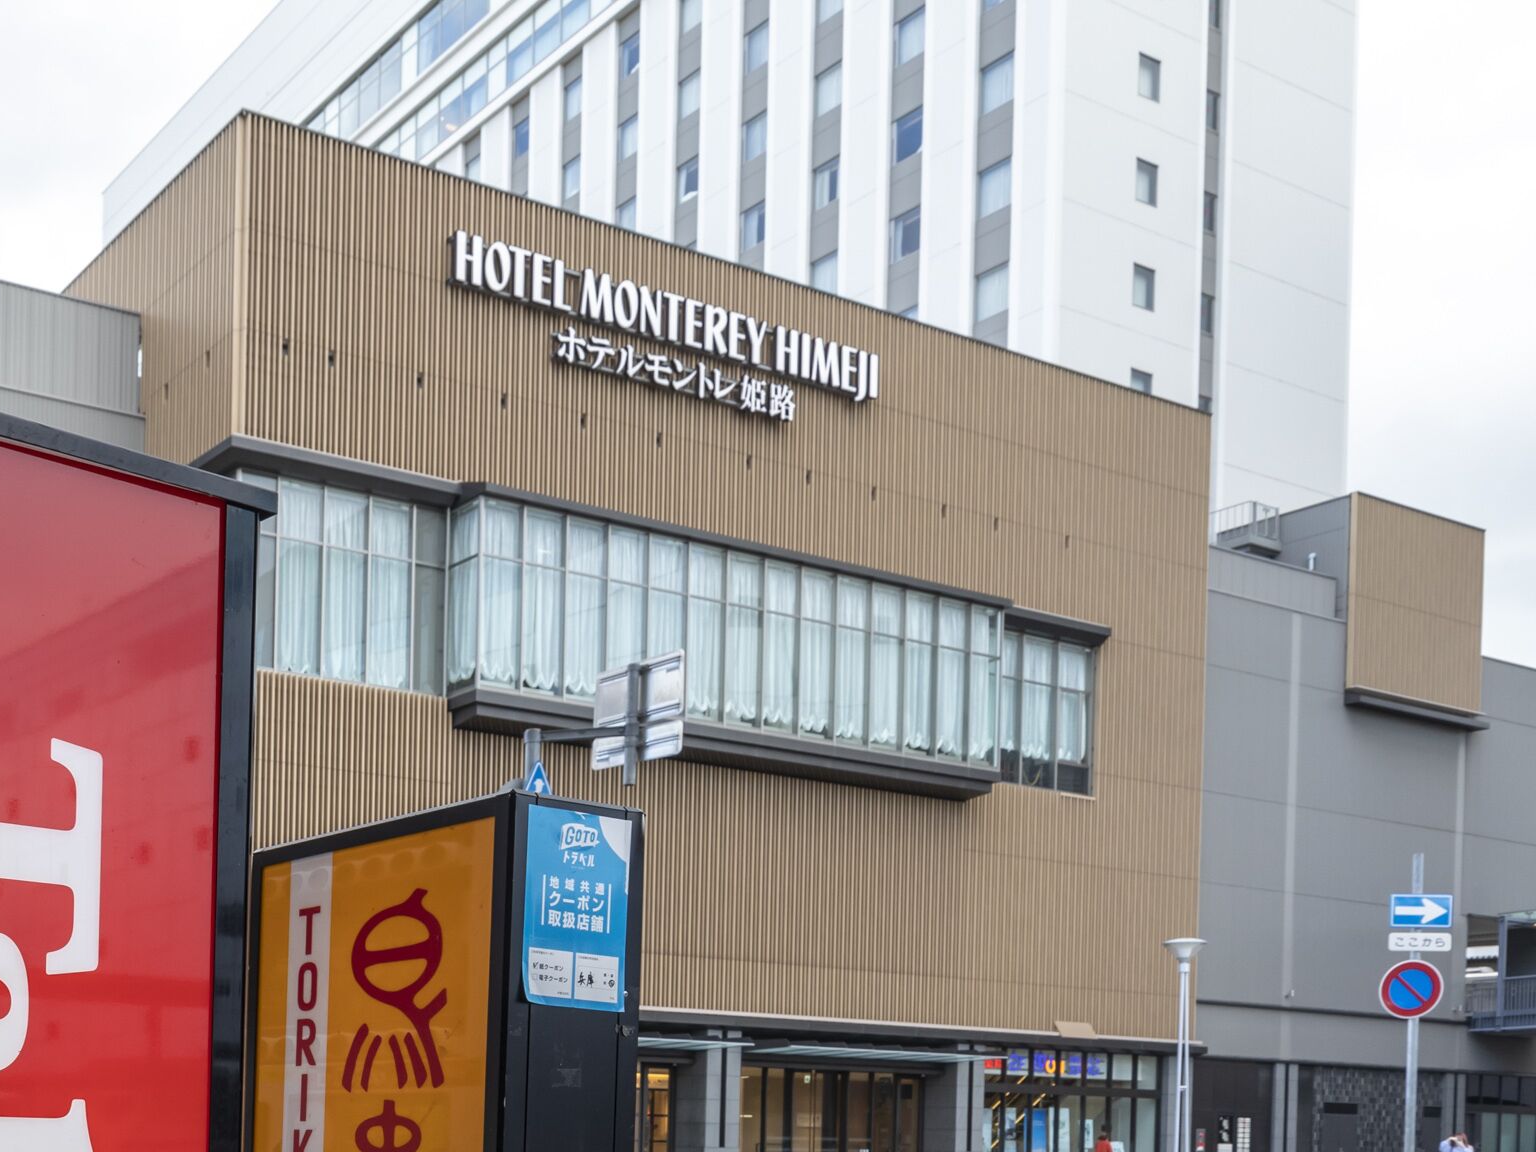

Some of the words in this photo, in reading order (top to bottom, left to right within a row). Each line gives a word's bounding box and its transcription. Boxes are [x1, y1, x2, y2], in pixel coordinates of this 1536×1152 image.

[454, 229, 571, 312] HOTEL
[580, 267, 768, 365] MONTEREY
[775, 325, 880, 402] HIMEJI
[556, 327, 796, 422] ホテルモントレ姫路
[563, 850, 595, 868] トラベル
[549, 891, 605, 912] クーポン
[547, 909, 604, 933] 取扱店舗
[1394, 936, 1447, 948] ここから
